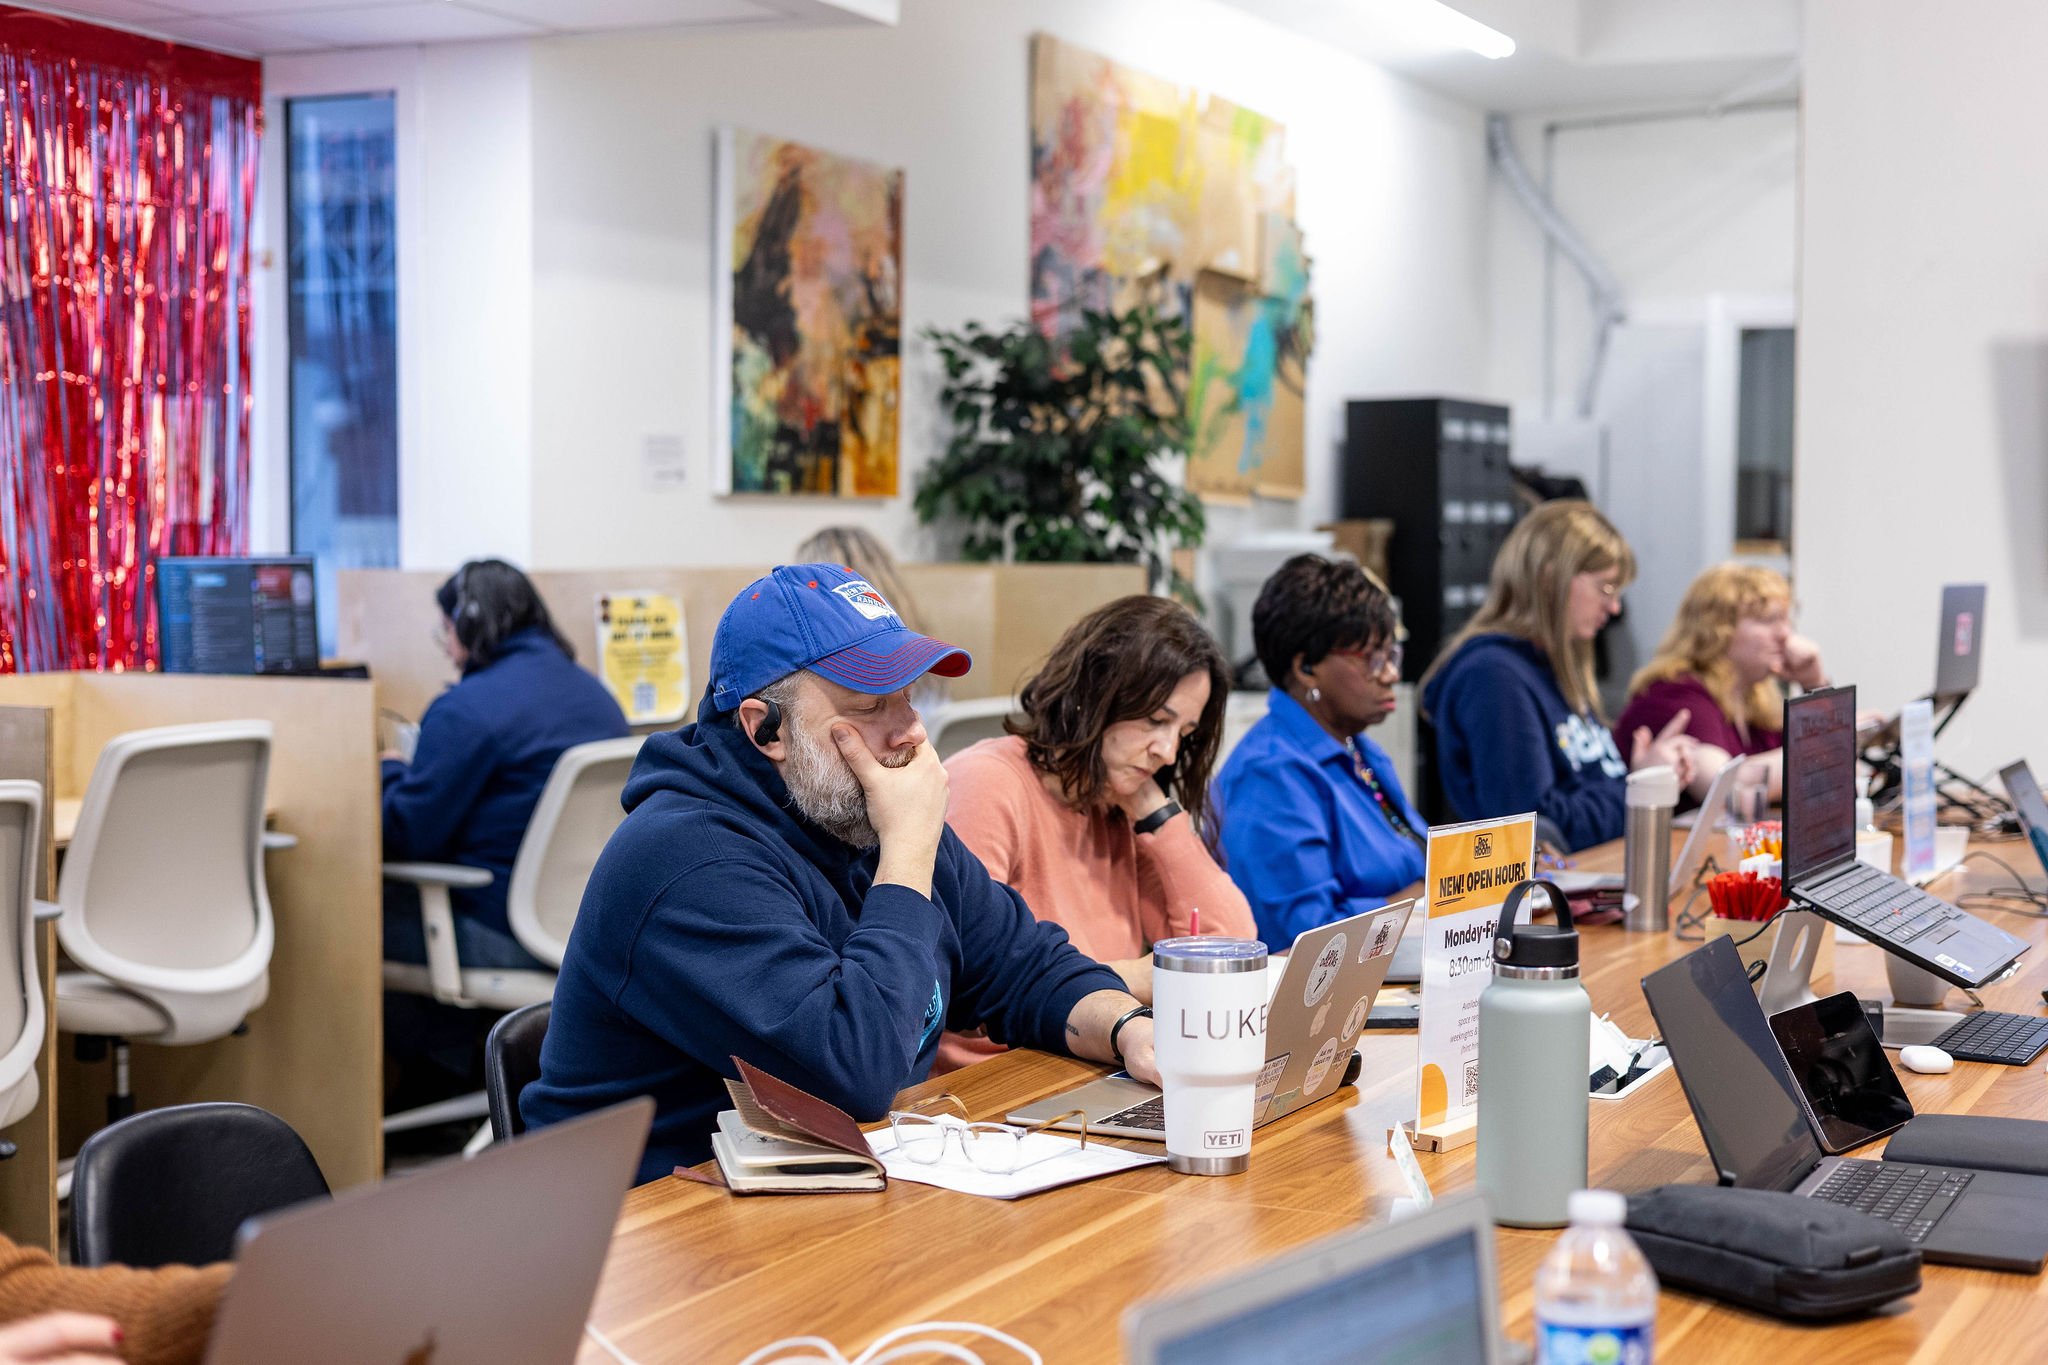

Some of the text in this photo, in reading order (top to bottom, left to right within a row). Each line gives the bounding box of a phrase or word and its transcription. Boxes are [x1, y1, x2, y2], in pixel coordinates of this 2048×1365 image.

[1440, 862, 1527, 898] NEW! OPEN HOURS
[1449, 949, 1493, 978] 8:30am-6
[1181, 1003, 1267, 1040] LUKE
[1450, 1030, 1474, 1043] weeknights
[1207, 1133, 1242, 1146] YETI
